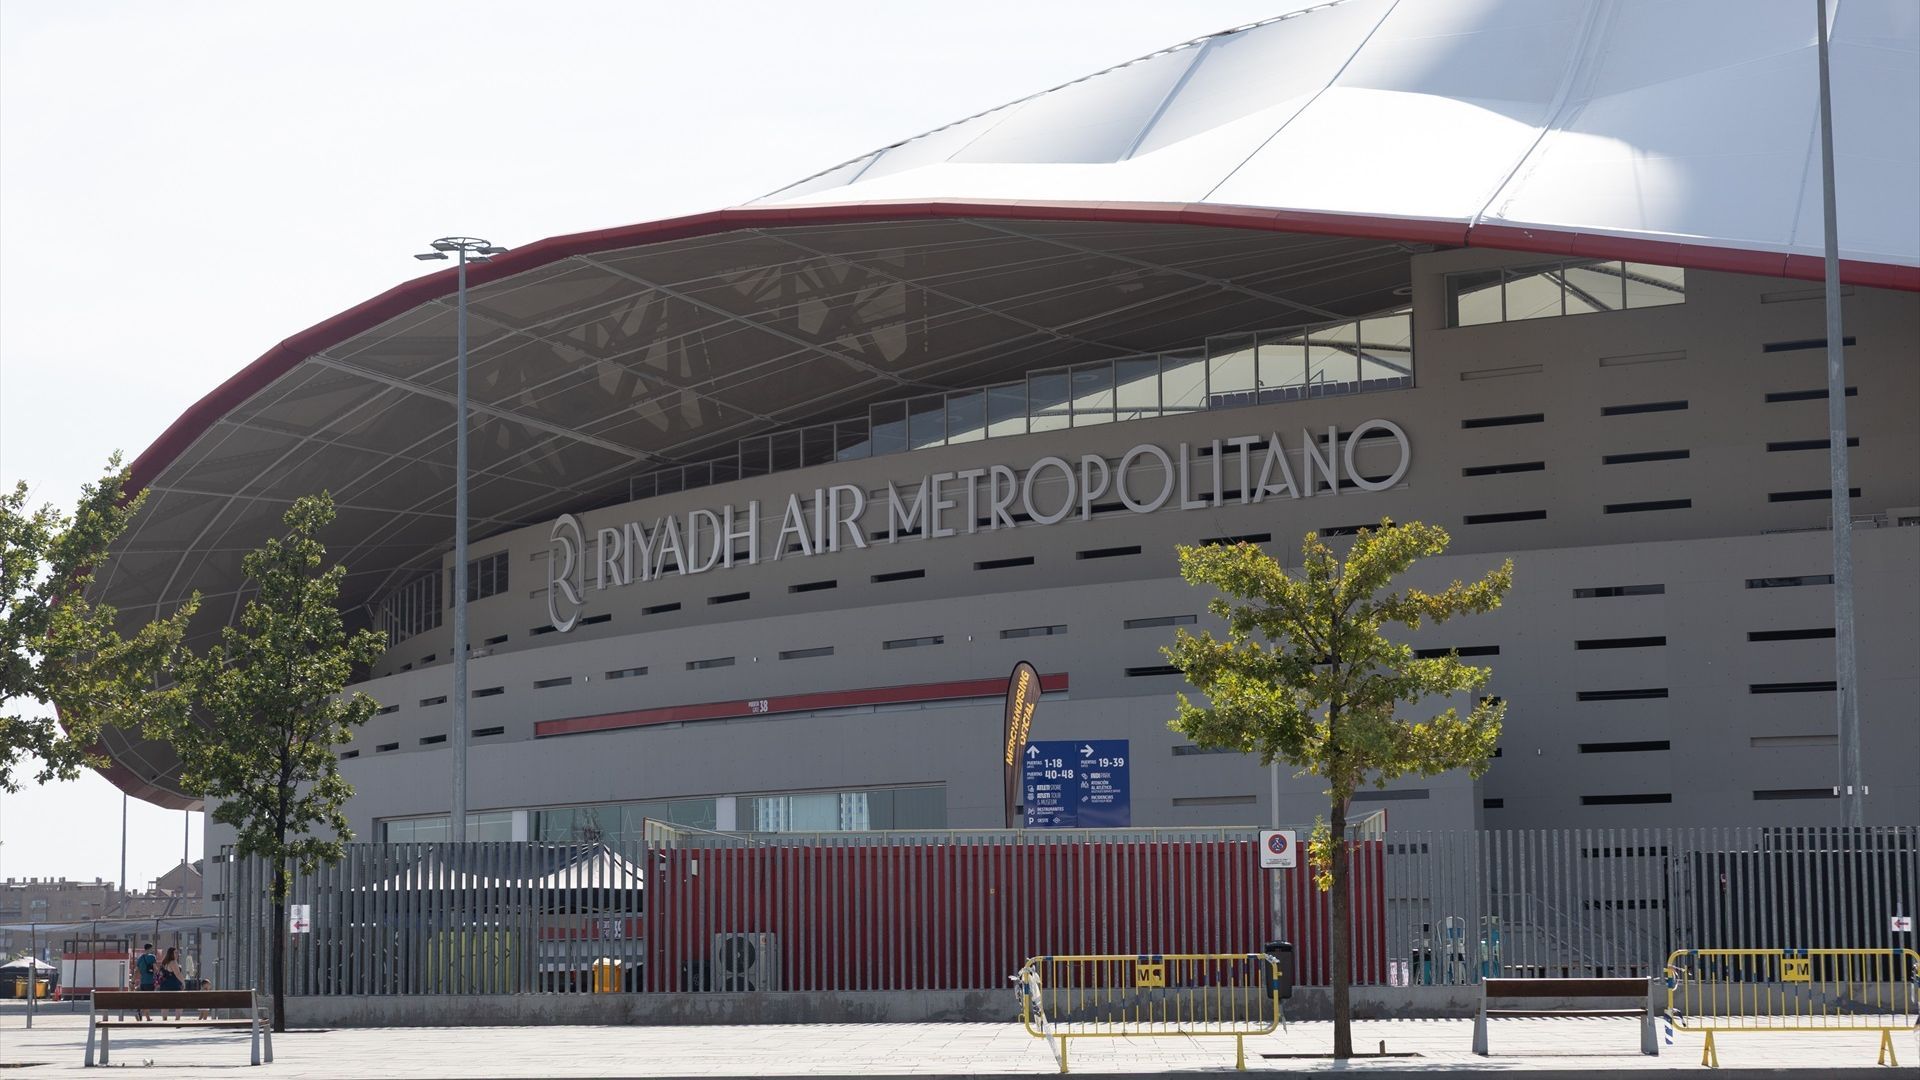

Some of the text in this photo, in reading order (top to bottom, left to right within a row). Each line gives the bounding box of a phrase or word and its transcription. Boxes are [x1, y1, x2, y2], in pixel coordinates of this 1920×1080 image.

[597, 418, 1412, 590] RIYADH AIR METROPOLITANO
[760, 700, 768, 712] 38
[1006, 670, 1030, 766] MERCHANDISING
[1019, 702, 1035, 746] OFICIAL
[1044, 758, 1063, 768] 1-18
[1098, 757, 1125, 768] 19-39
[1044, 769, 1074, 779] 40-48
[1028, 817, 1035, 825] P
[1783, 963, 1809, 976] PM
